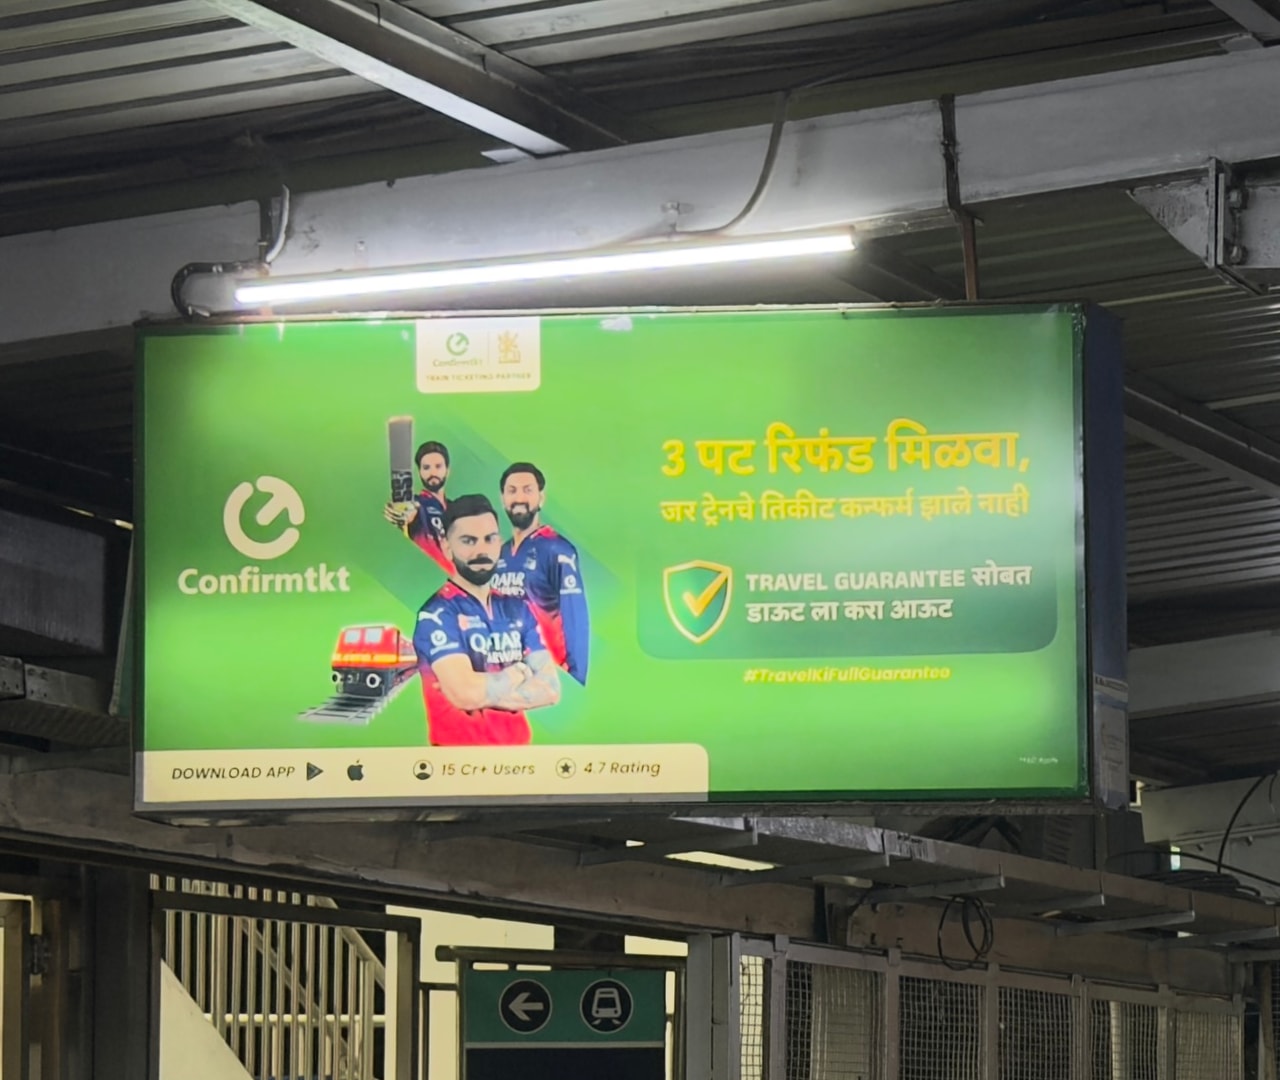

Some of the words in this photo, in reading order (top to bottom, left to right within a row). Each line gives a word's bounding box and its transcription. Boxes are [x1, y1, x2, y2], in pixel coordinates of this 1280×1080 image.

[660, 439, 686, 478] 3
[694, 437, 756, 476] पट
[764, 420, 877, 475] रिफंड
[885, 417, 1031, 474] मिळवा,
[660, 498, 697, 522] जर
[702, 490, 755, 527] ट्रेनचे
[761, 489, 836, 520] तिकीट
[920, 486, 973, 521] झाले
[977, 482, 1030, 517] नाही
[178, 563, 351, 597] Confirmtkt
[745, 571, 828, 593] TRAVEL
[834, 569, 966, 590] GUARANTEE
[971, 558, 1032, 588] सोबत
[745, 600, 805, 624] डाऊट
[810, 600, 838, 622] ला
[843, 599, 883, 622] करा
[890, 597, 953, 621] आऊट
[171, 765, 261, 780] DOWNLOAD
[266, 765, 295, 780] APP
[441, 763, 457, 777] 15
[460, 762, 488, 777] Cr+
[493, 762, 536, 776] Users
[583, 761, 606, 777] 4.7
[610, 760, 661, 779] Rating
